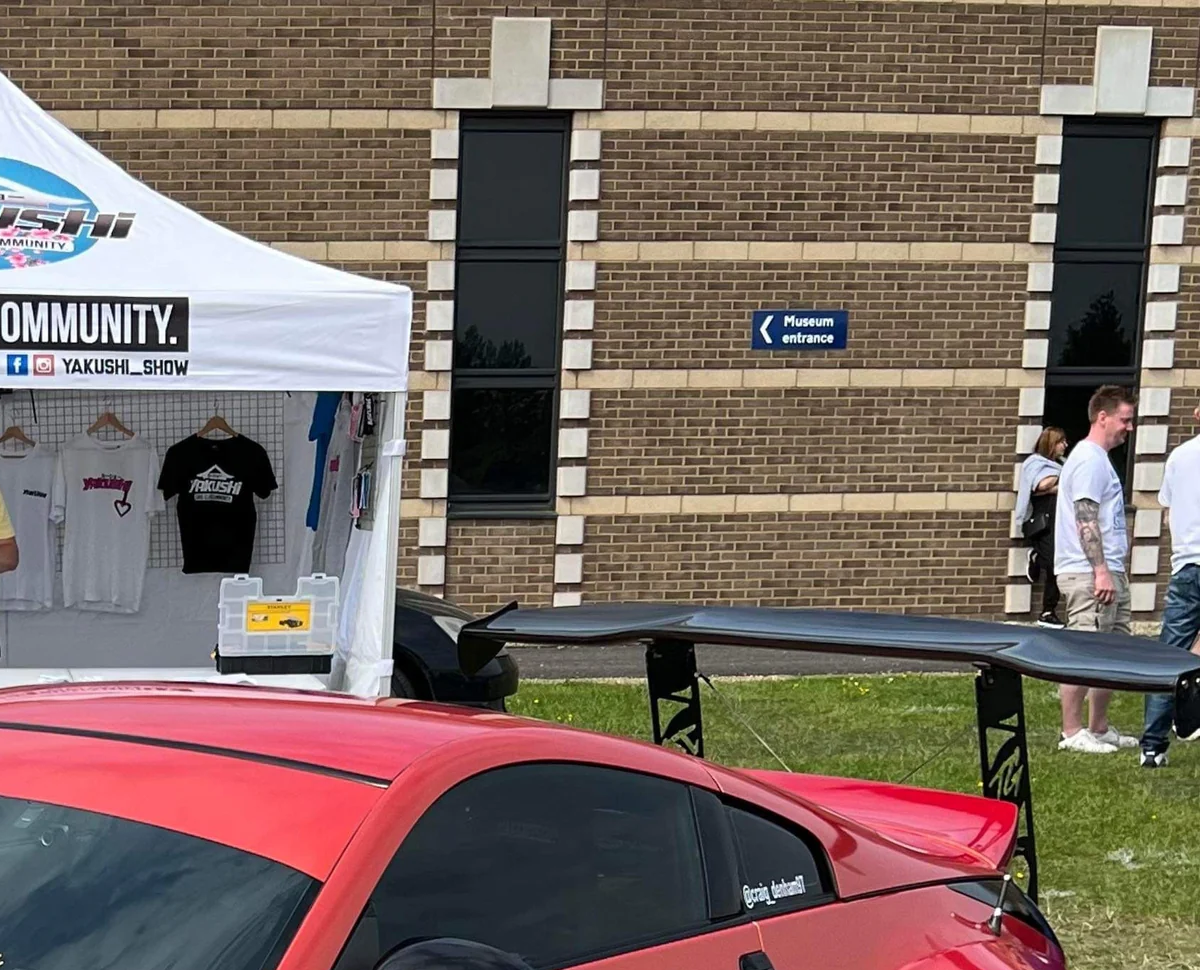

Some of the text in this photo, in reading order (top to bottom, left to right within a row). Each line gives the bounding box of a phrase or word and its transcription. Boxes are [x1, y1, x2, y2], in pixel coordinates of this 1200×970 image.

[783, 315, 834, 327] Museum
[782, 332, 834, 344] entrance
[62, 358, 189, 376] YAKUSHI_SHOW
